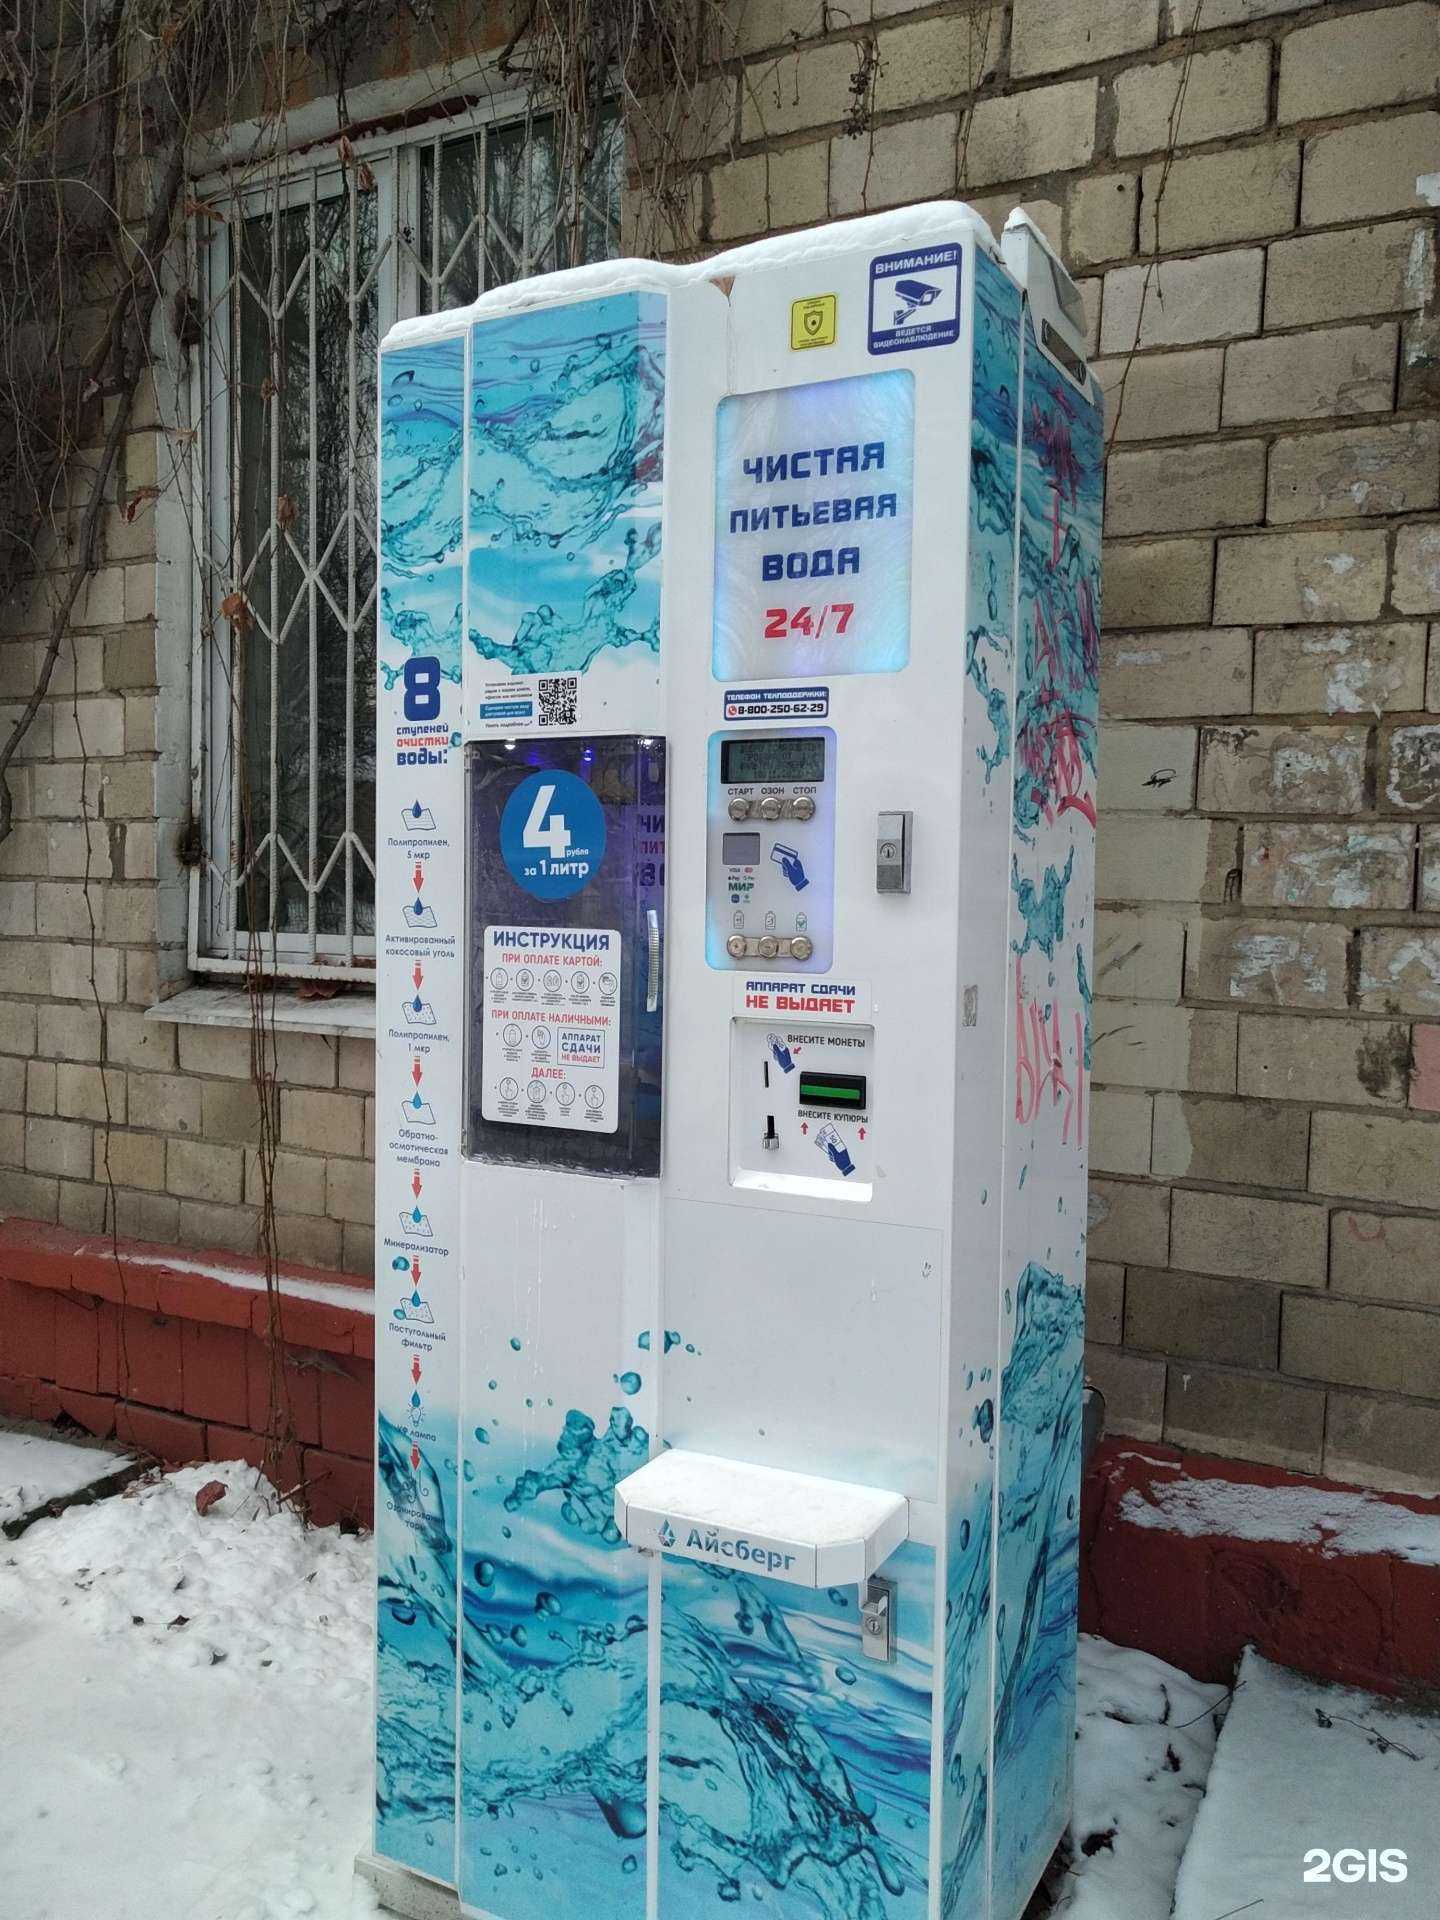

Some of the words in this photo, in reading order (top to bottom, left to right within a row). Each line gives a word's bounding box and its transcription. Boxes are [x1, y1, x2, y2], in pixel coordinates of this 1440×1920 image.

[875, 250, 957, 274] ВНИМАНИЕ!
[895, 325, 932, 337] ВЕДЕТСЯ
[873, 330, 955, 349] ВИДЕОНАБЛЮДЕНИЕ
[743, 442, 885, 483] ЧИСТАЯ
[730, 493, 897, 533] ПИТЬЕВАЯ
[762, 547, 860, 581] ВОДА
[764, 603, 854, 639] 24/7
[403, 656, 441, 722] 8
[727, 693, 761, 701] ТЕЛЕФОН
[738, 703, 824, 715] 8-800-250-62-29
[396, 724, 449, 738] ступеней
[396, 736, 449, 748] очистки
[397, 748, 448, 766] воды:
[761, 787, 784, 795] ОЗОН
[793, 786, 817, 794] СТОП
[523, 785, 571, 859] 4
[566, 848, 589, 857] рубля
[387, 838, 450, 849] Полипропилен,
[407, 850, 412, 859] 5
[414, 852, 430, 861] мкр
[524, 868, 537, 876] за
[540, 860, 547, 875] 1
[550, 862, 589, 878] литр
[728, 882, 755, 892] МИР
[386, 933, 455, 945] Активированный
[493, 931, 609, 951] ИНСТРУКЦИЯ
[386, 947, 431, 957] кокосовый
[433, 949, 455, 959] уголь
[502, 953, 520, 963] ПРИ
[524, 954, 560, 965] ОПЛАТЕ
[563, 954, 603, 967] КАРТОЙ:
[746, 980, 806, 993] АППАРАТ
[811, 983, 856, 996] СДАЧИ
[746, 995, 769, 1009] НЕ
[776, 997, 856, 1013] ВЫДАЕТ
[491, 1009, 509, 1020] ПРИ
[512, 1011, 546, 1022] ОПЛАТЕ
[549, 1013, 611, 1027] НАЛИЧНЫМИ:
[388, 1028, 450, 1042] Полипропилен,
[561, 1032, 601, 1042] АППАРАТ
[787, 1034, 825, 1045] ВНЕСИТЕ
[827, 1037, 866, 1048] МОНЕТЫ
[408, 1044, 412, 1052] 1
[414, 1046, 431, 1055] мкр
[561, 1042, 601, 1054] СДАЧИ
[561, 1053, 571, 1062] НЕ
[572, 1054, 600, 1063] ВЫДАЕТ
[531, 1067, 567, 1080] ДАЛЕЕ:
[798, 1109, 832, 1120] ВНЕСИТЕ
[834, 1113, 869, 1124] КУПЮРЫ
[398, 1129, 438, 1141] Обратно-
[389, 1142, 449, 1156] осмотическая
[396, 1155, 441, 1167] мембрана
[384, 1238, 449, 1257] Минерализатор
[388, 1323, 446, 1342] Постугольный
[401, 1338, 433, 1353] фильтр
[409, 1431, 437, 1442] лампа
[686, 1528, 797, 1572] Айсберг
